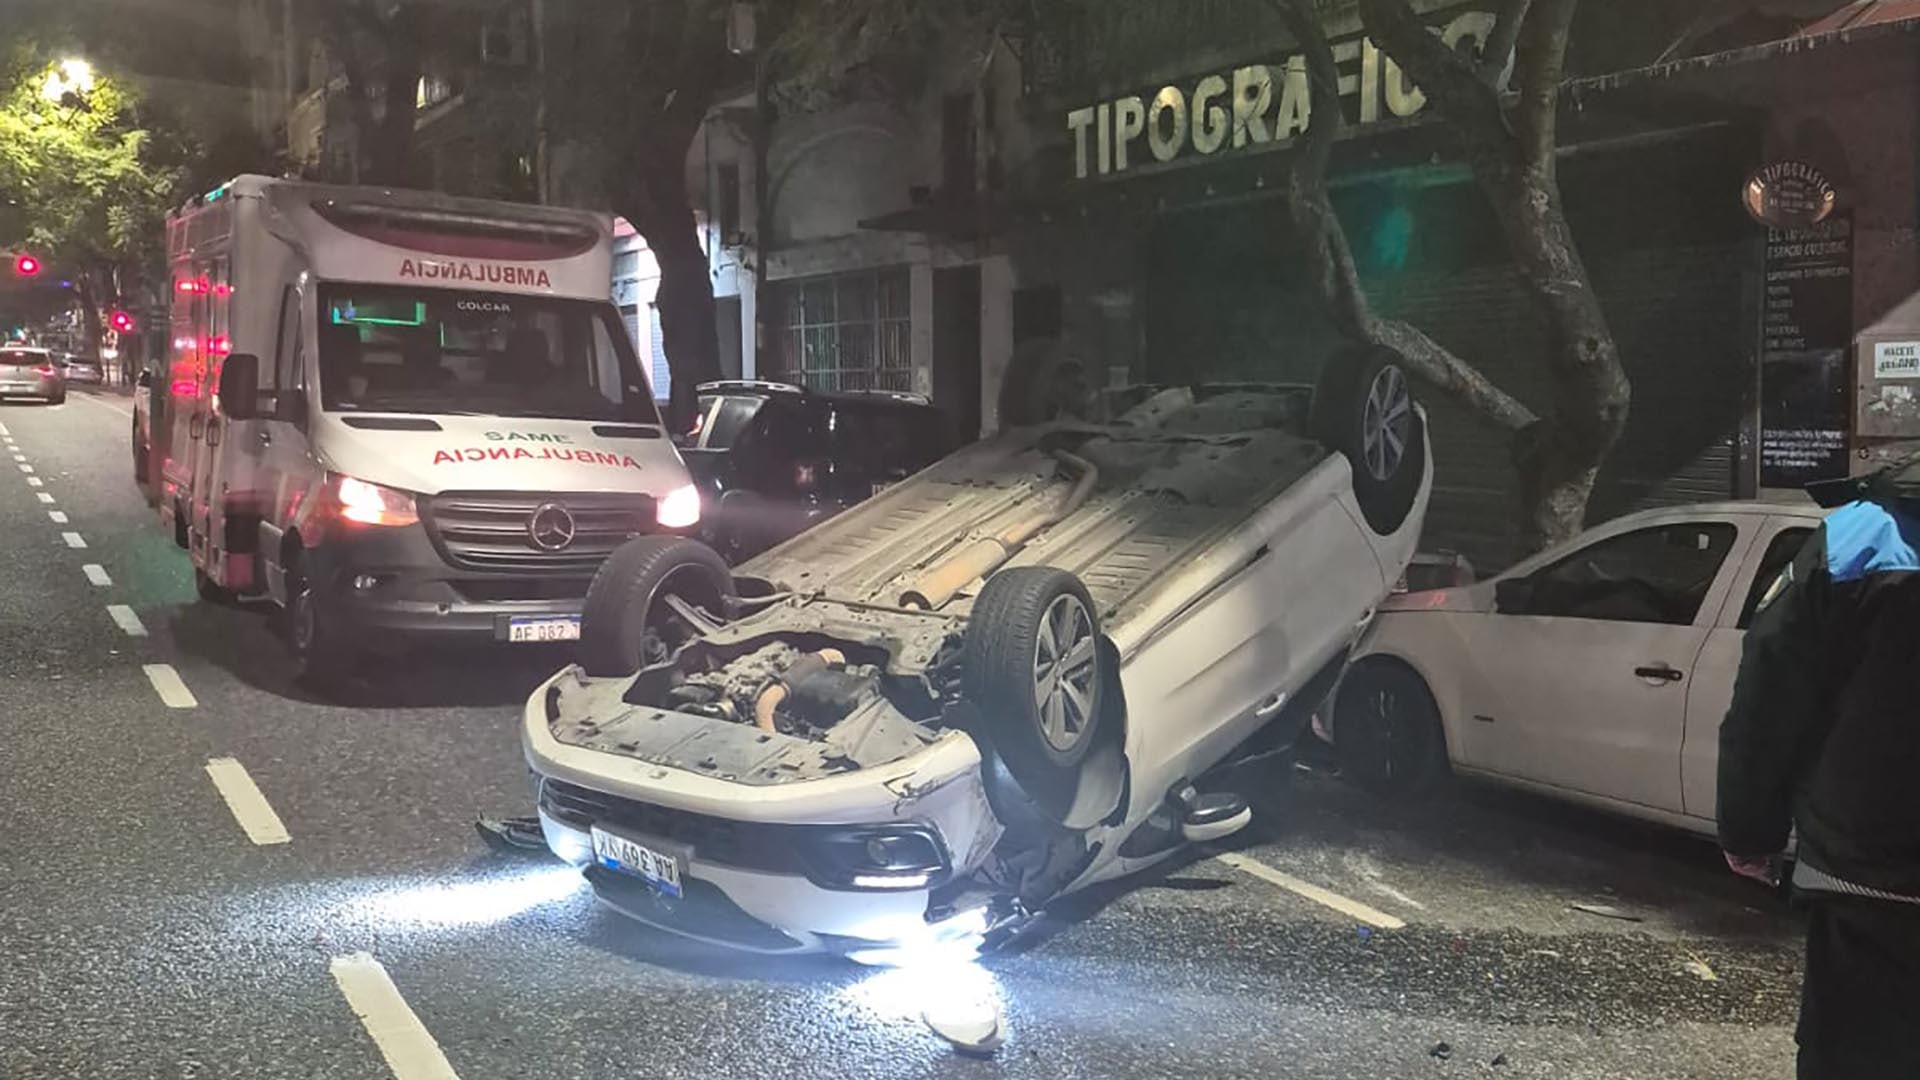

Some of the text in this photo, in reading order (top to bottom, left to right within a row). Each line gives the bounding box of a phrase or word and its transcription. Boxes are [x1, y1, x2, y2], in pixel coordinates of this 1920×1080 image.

[456, 301, 511, 312] COLCAR
[484, 431, 575, 445] SAME
[515, 626, 533, 640] AF
